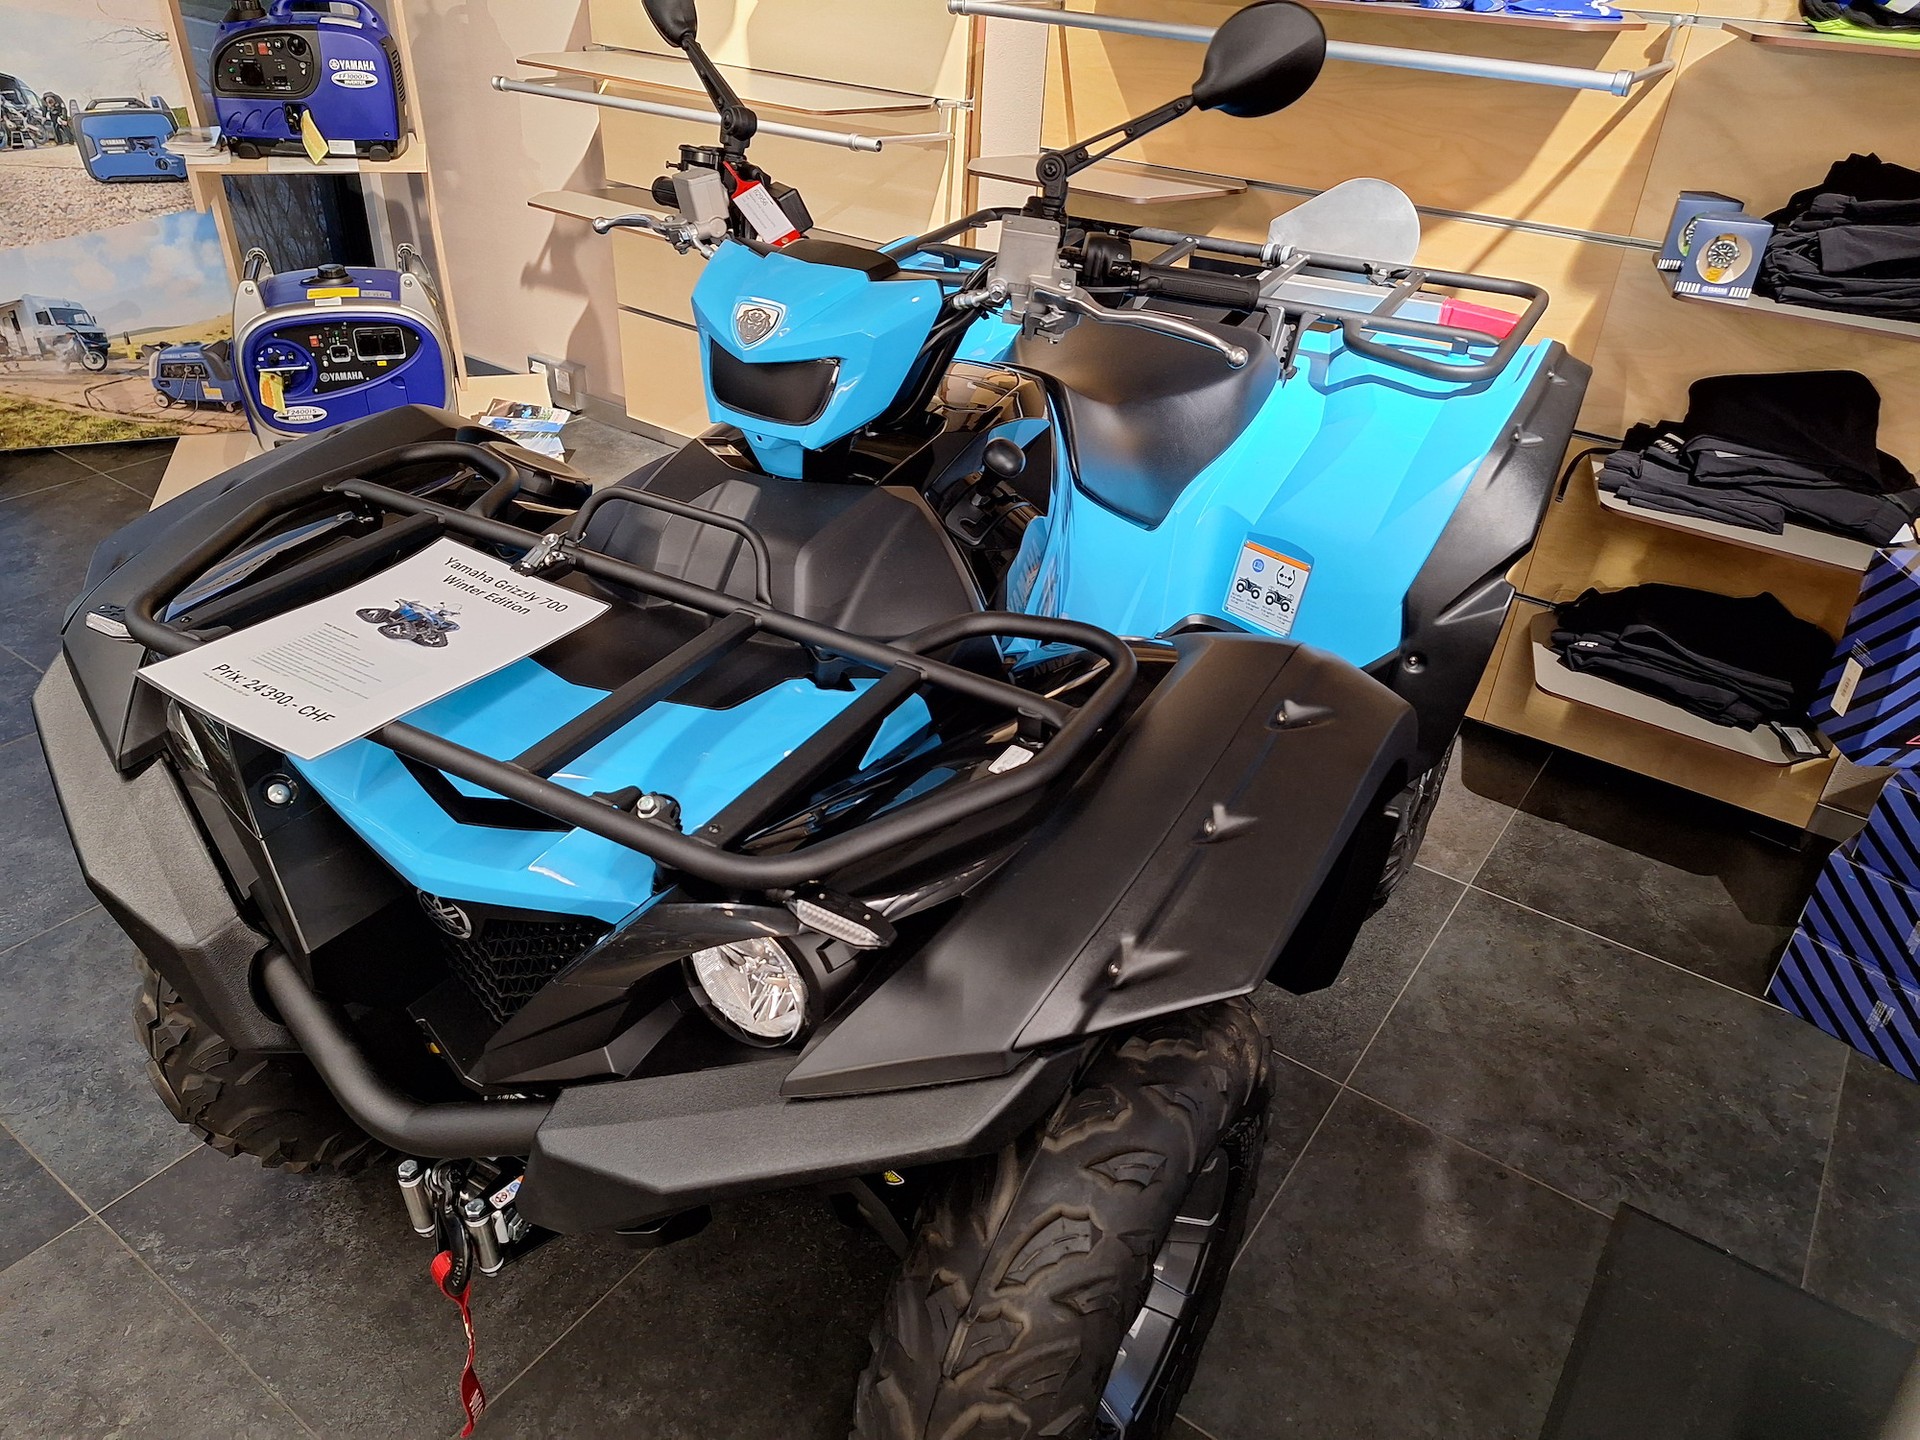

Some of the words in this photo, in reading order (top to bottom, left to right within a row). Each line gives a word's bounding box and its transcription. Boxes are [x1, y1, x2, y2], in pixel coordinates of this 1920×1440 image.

[339, 60, 376, 71] YAMAHA
[329, 371, 364, 382] YAMAHA
[442, 574, 486, 596] Winter
[484, 592, 531, 615] Edition
[444, 556, 494, 584] Yamaha
[494, 579, 541, 602] Grizzly
[539, 597, 569, 613] 700
[211, 663, 247, 684] Prix:
[297, 705, 336, 723] CHF
